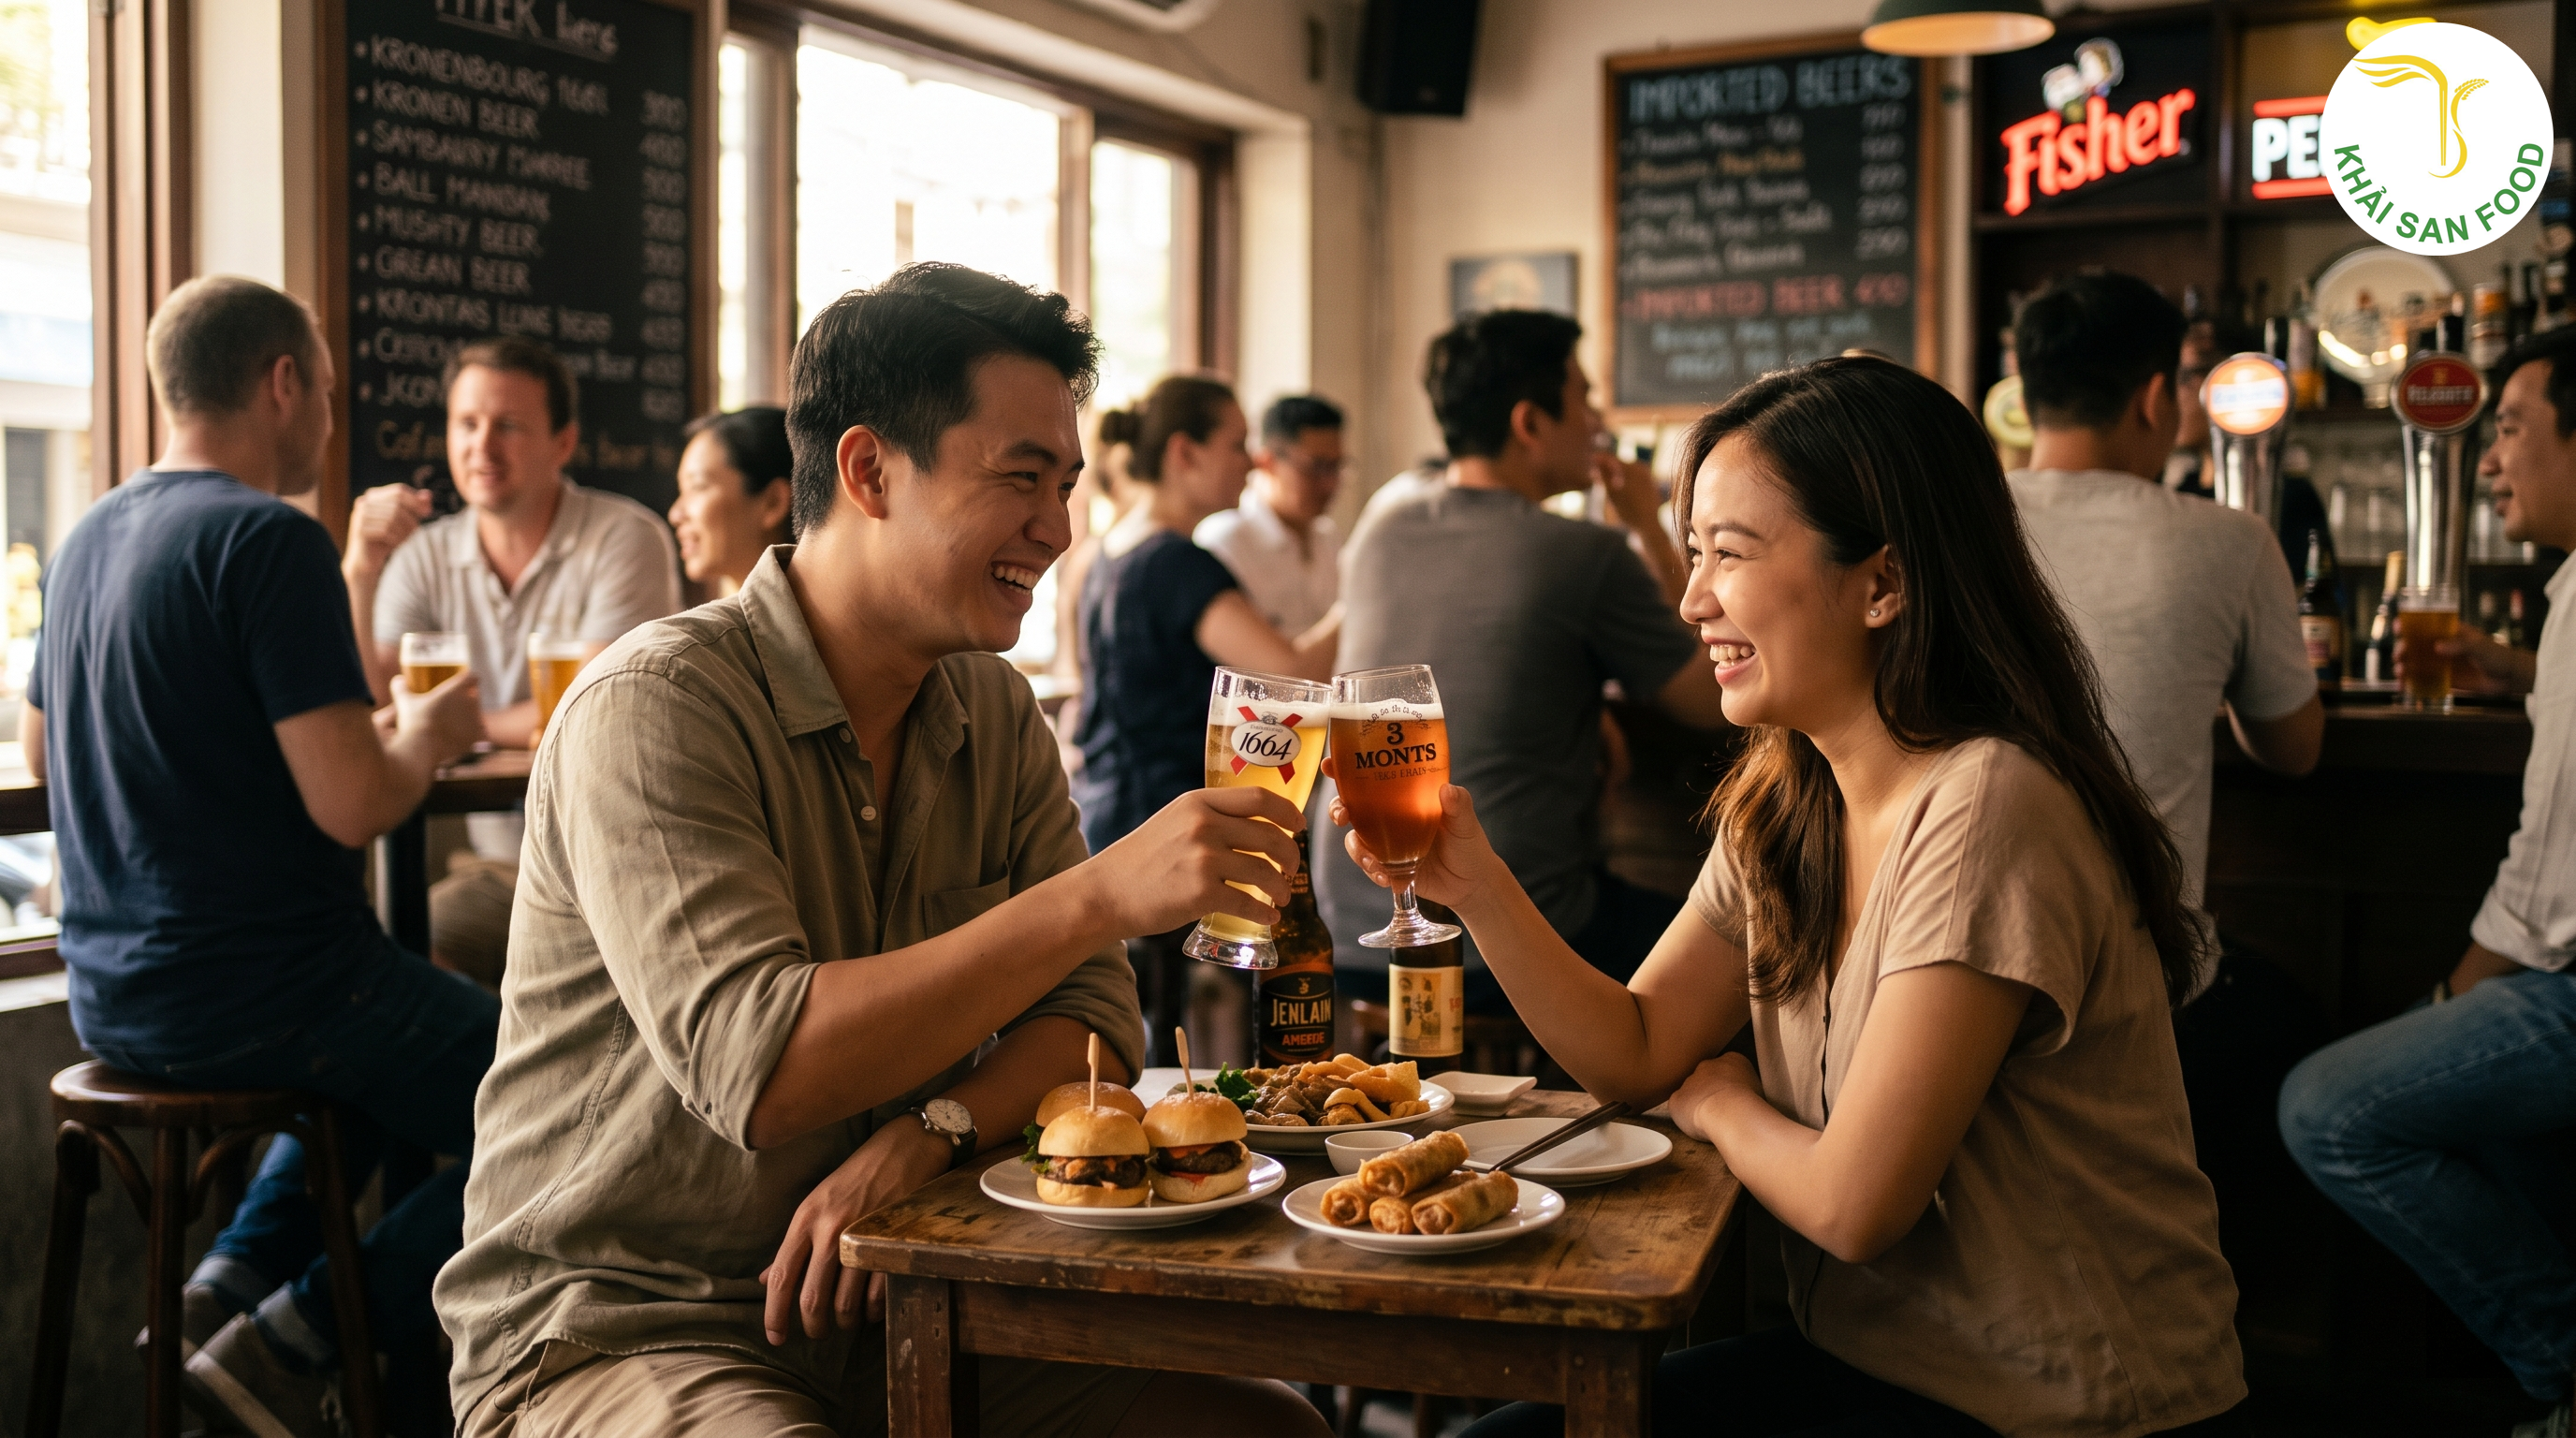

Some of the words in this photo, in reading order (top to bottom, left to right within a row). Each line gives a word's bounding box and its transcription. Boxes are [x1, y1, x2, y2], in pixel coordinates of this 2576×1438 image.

[1795, 52, 1910, 109] BEERS
[478, 97, 541, 141] BEER
[2001, 88, 2196, 217] Fisher
[2251, 114, 2325, 183] PE
[1238, 731, 1293, 760] 1664
[1386, 722, 1404, 745] 3
[1354, 742, 1437, 769] MONTS
[1270, 997, 1332, 1027] JENLAIN
